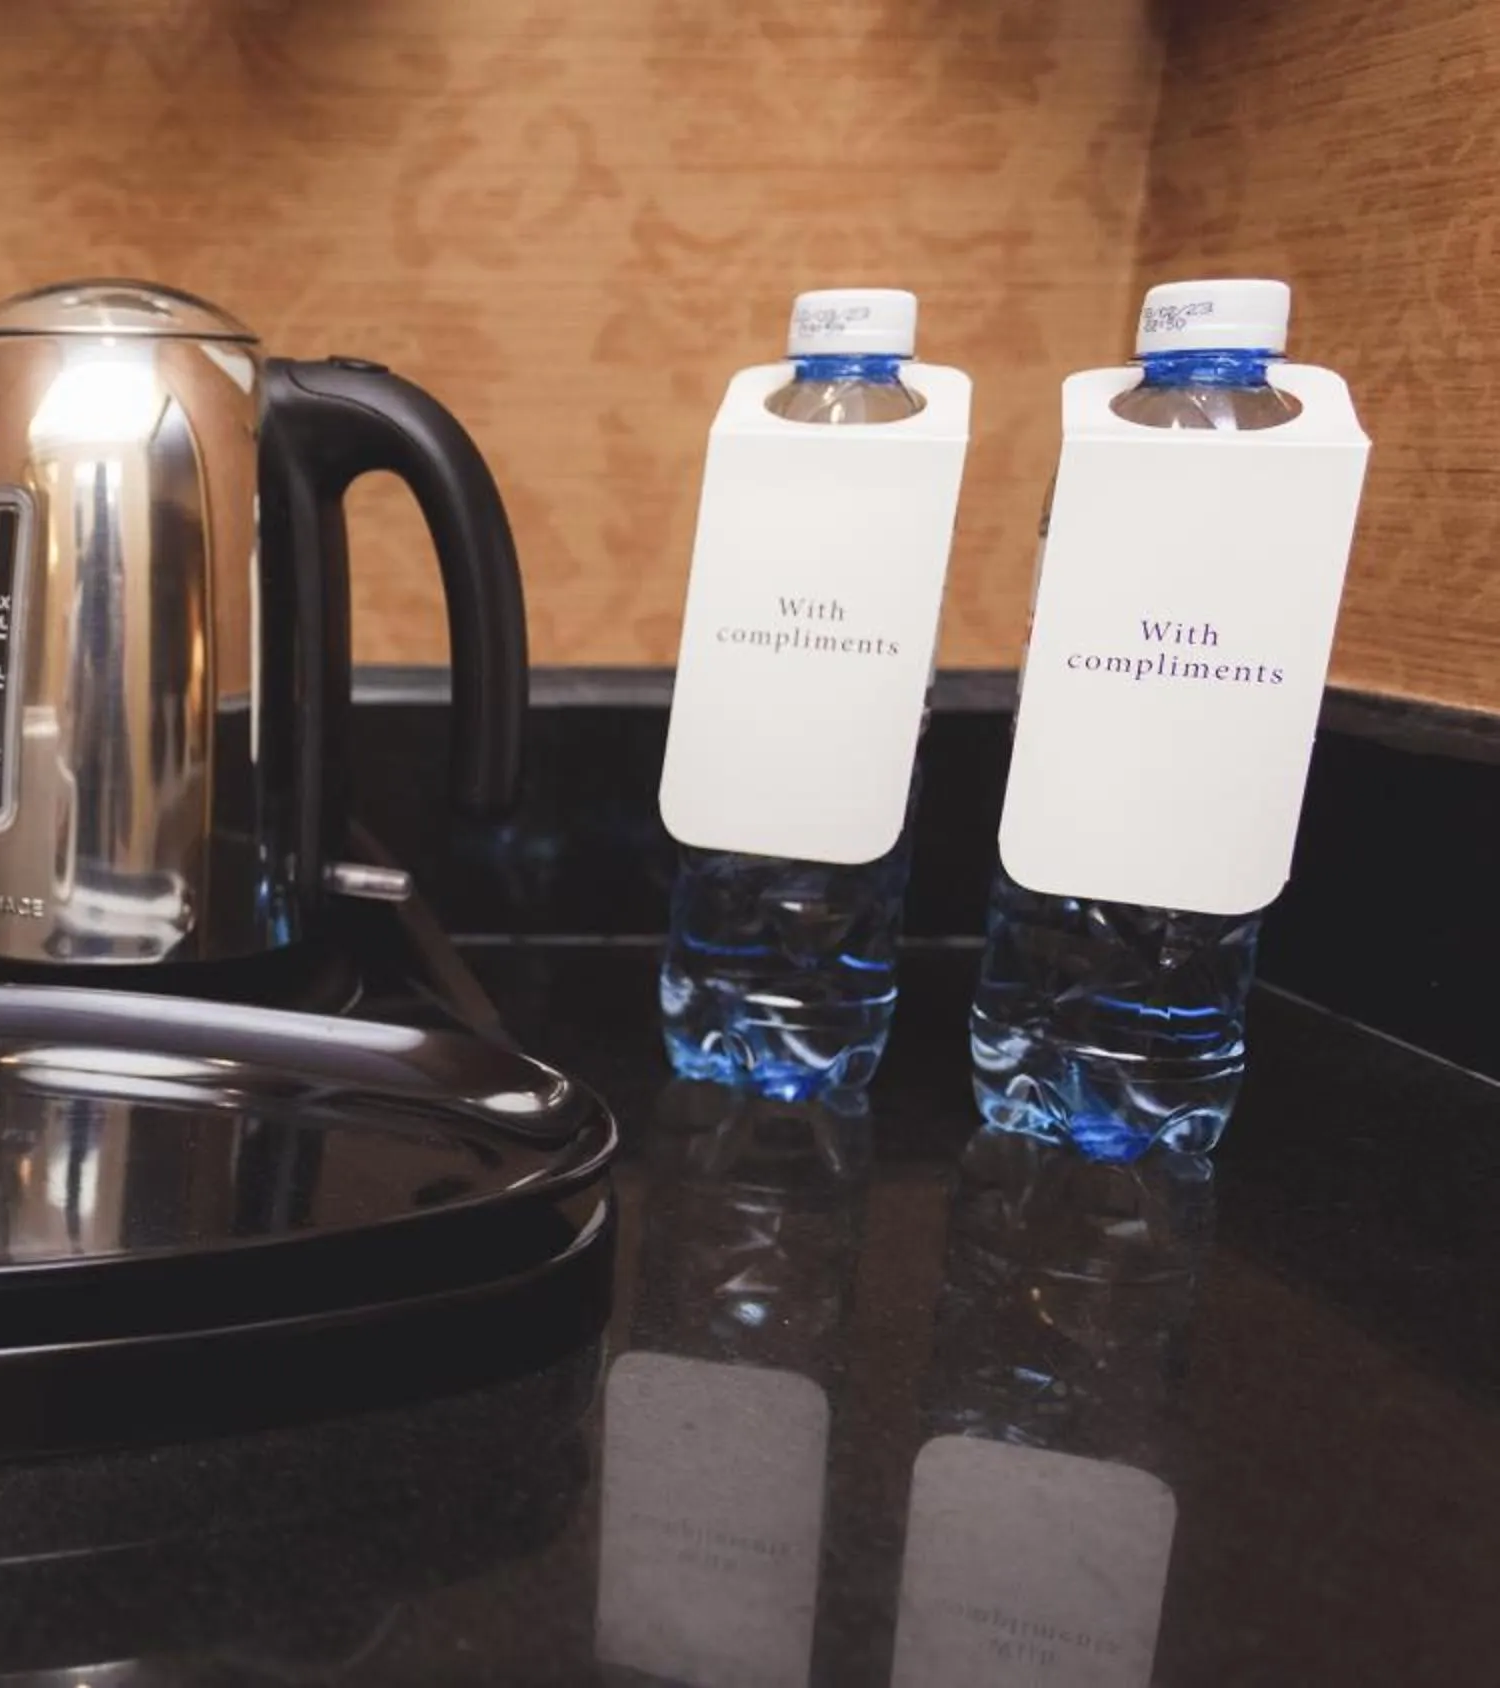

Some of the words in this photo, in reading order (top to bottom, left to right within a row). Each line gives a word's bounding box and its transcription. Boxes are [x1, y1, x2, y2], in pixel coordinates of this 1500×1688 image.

[777, 596, 845, 622] With
[715, 625, 901, 656] compliments
[1140, 619, 1219, 647] With
[1066, 652, 1285, 685] compliments
